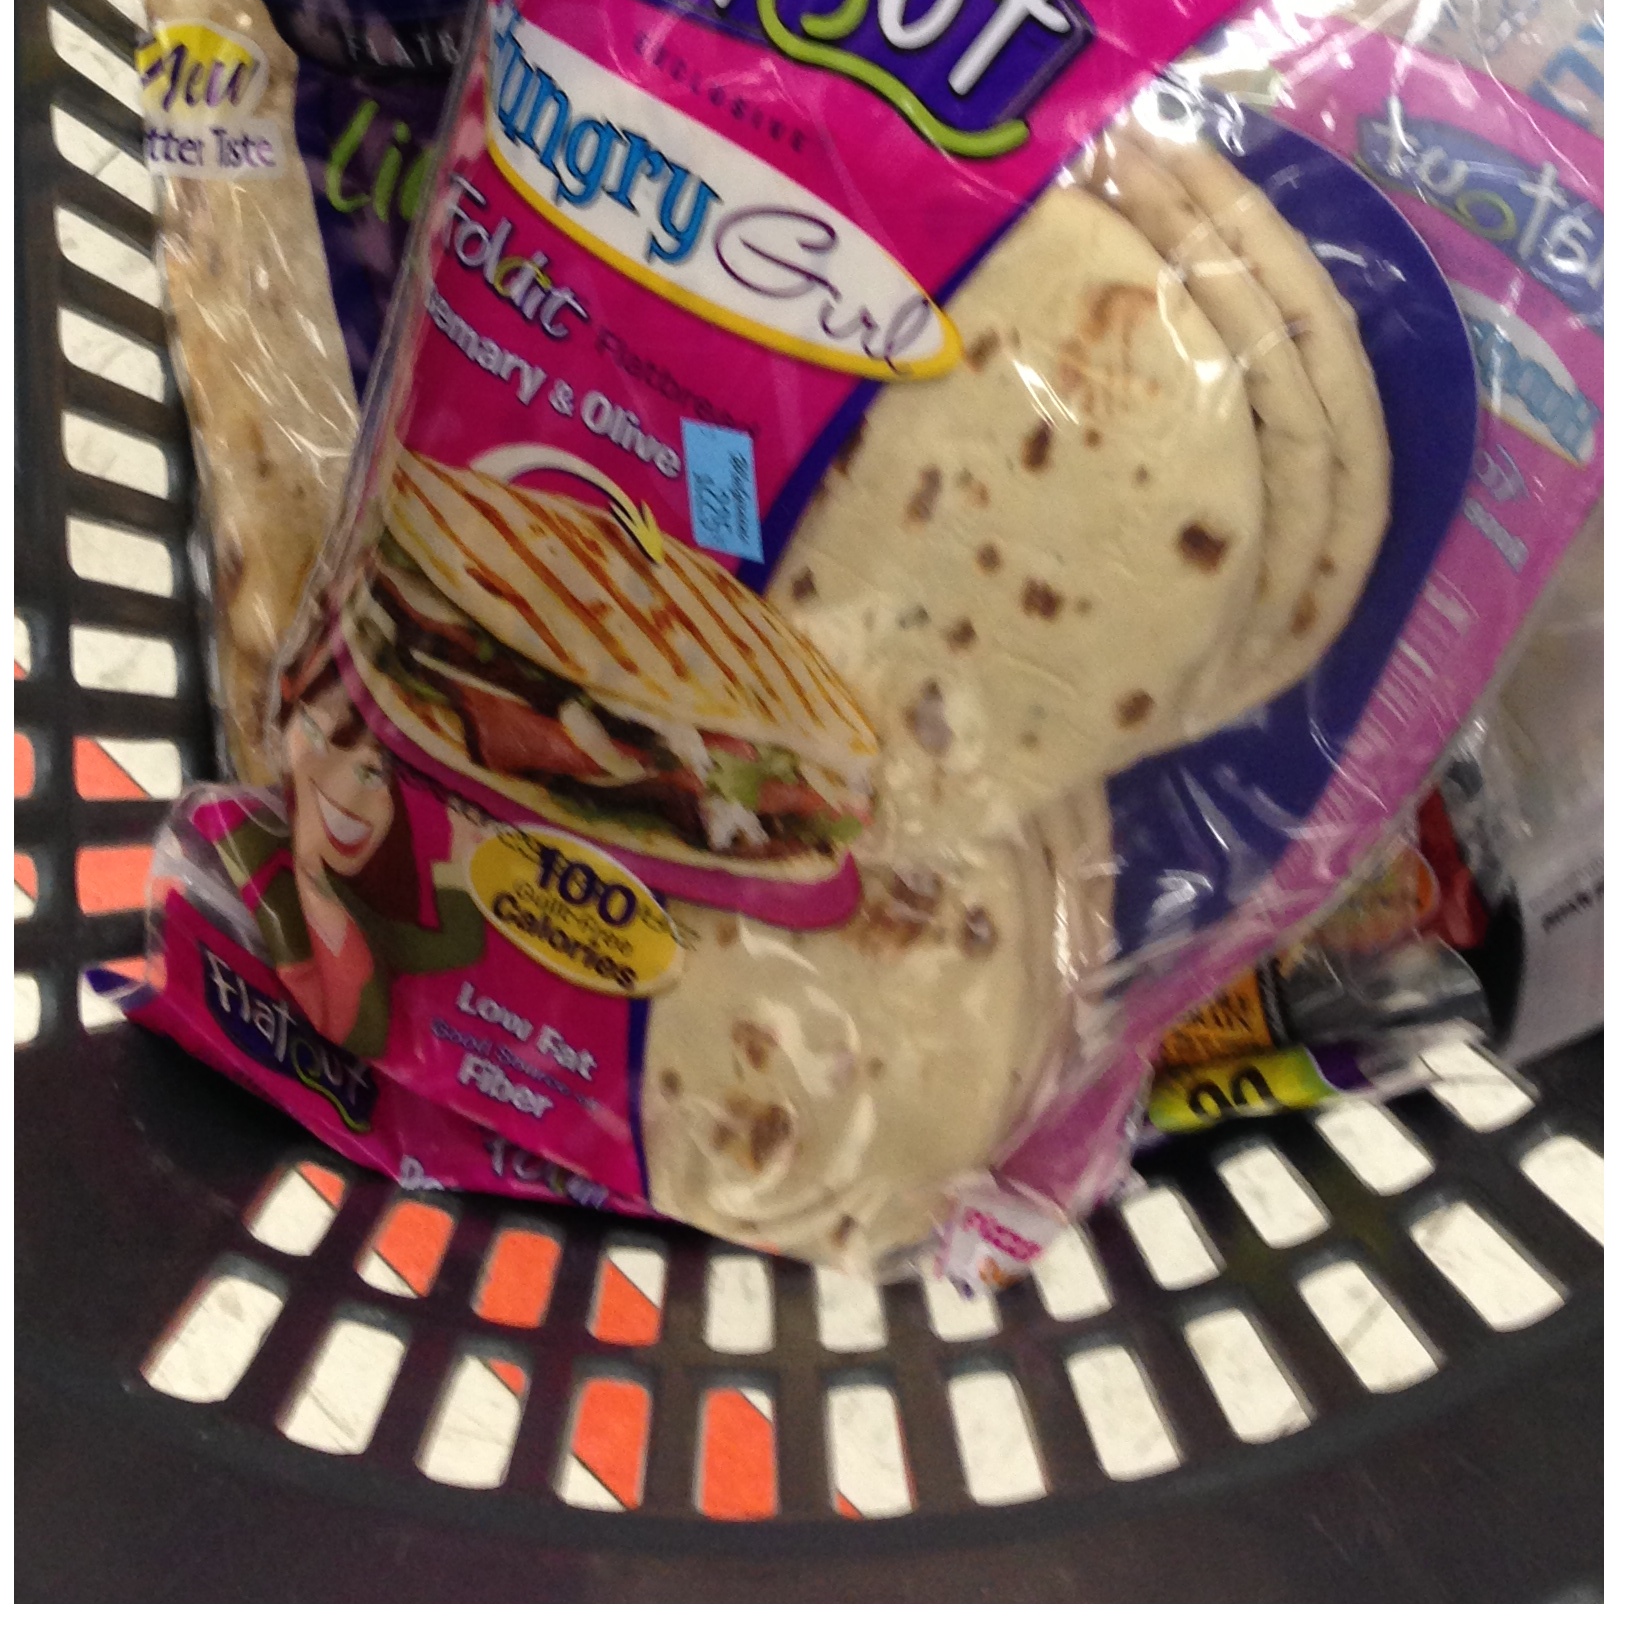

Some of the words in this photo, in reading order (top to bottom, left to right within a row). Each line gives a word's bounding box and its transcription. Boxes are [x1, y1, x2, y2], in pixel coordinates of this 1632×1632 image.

[147, 128, 206, 166] tter
[488, 18, 723, 264] ungry
[714, 203, 930, 374] Girl
[425, 281, 544, 405] emary
[581, 392, 683, 480] Olive
[533, 844, 641, 930] 100
[492, 891, 638, 991] Calories
[456, 981, 533, 1039] Low
[534, 1018, 599, 1083] Fat
[458, 1051, 553, 1119] Fiber
